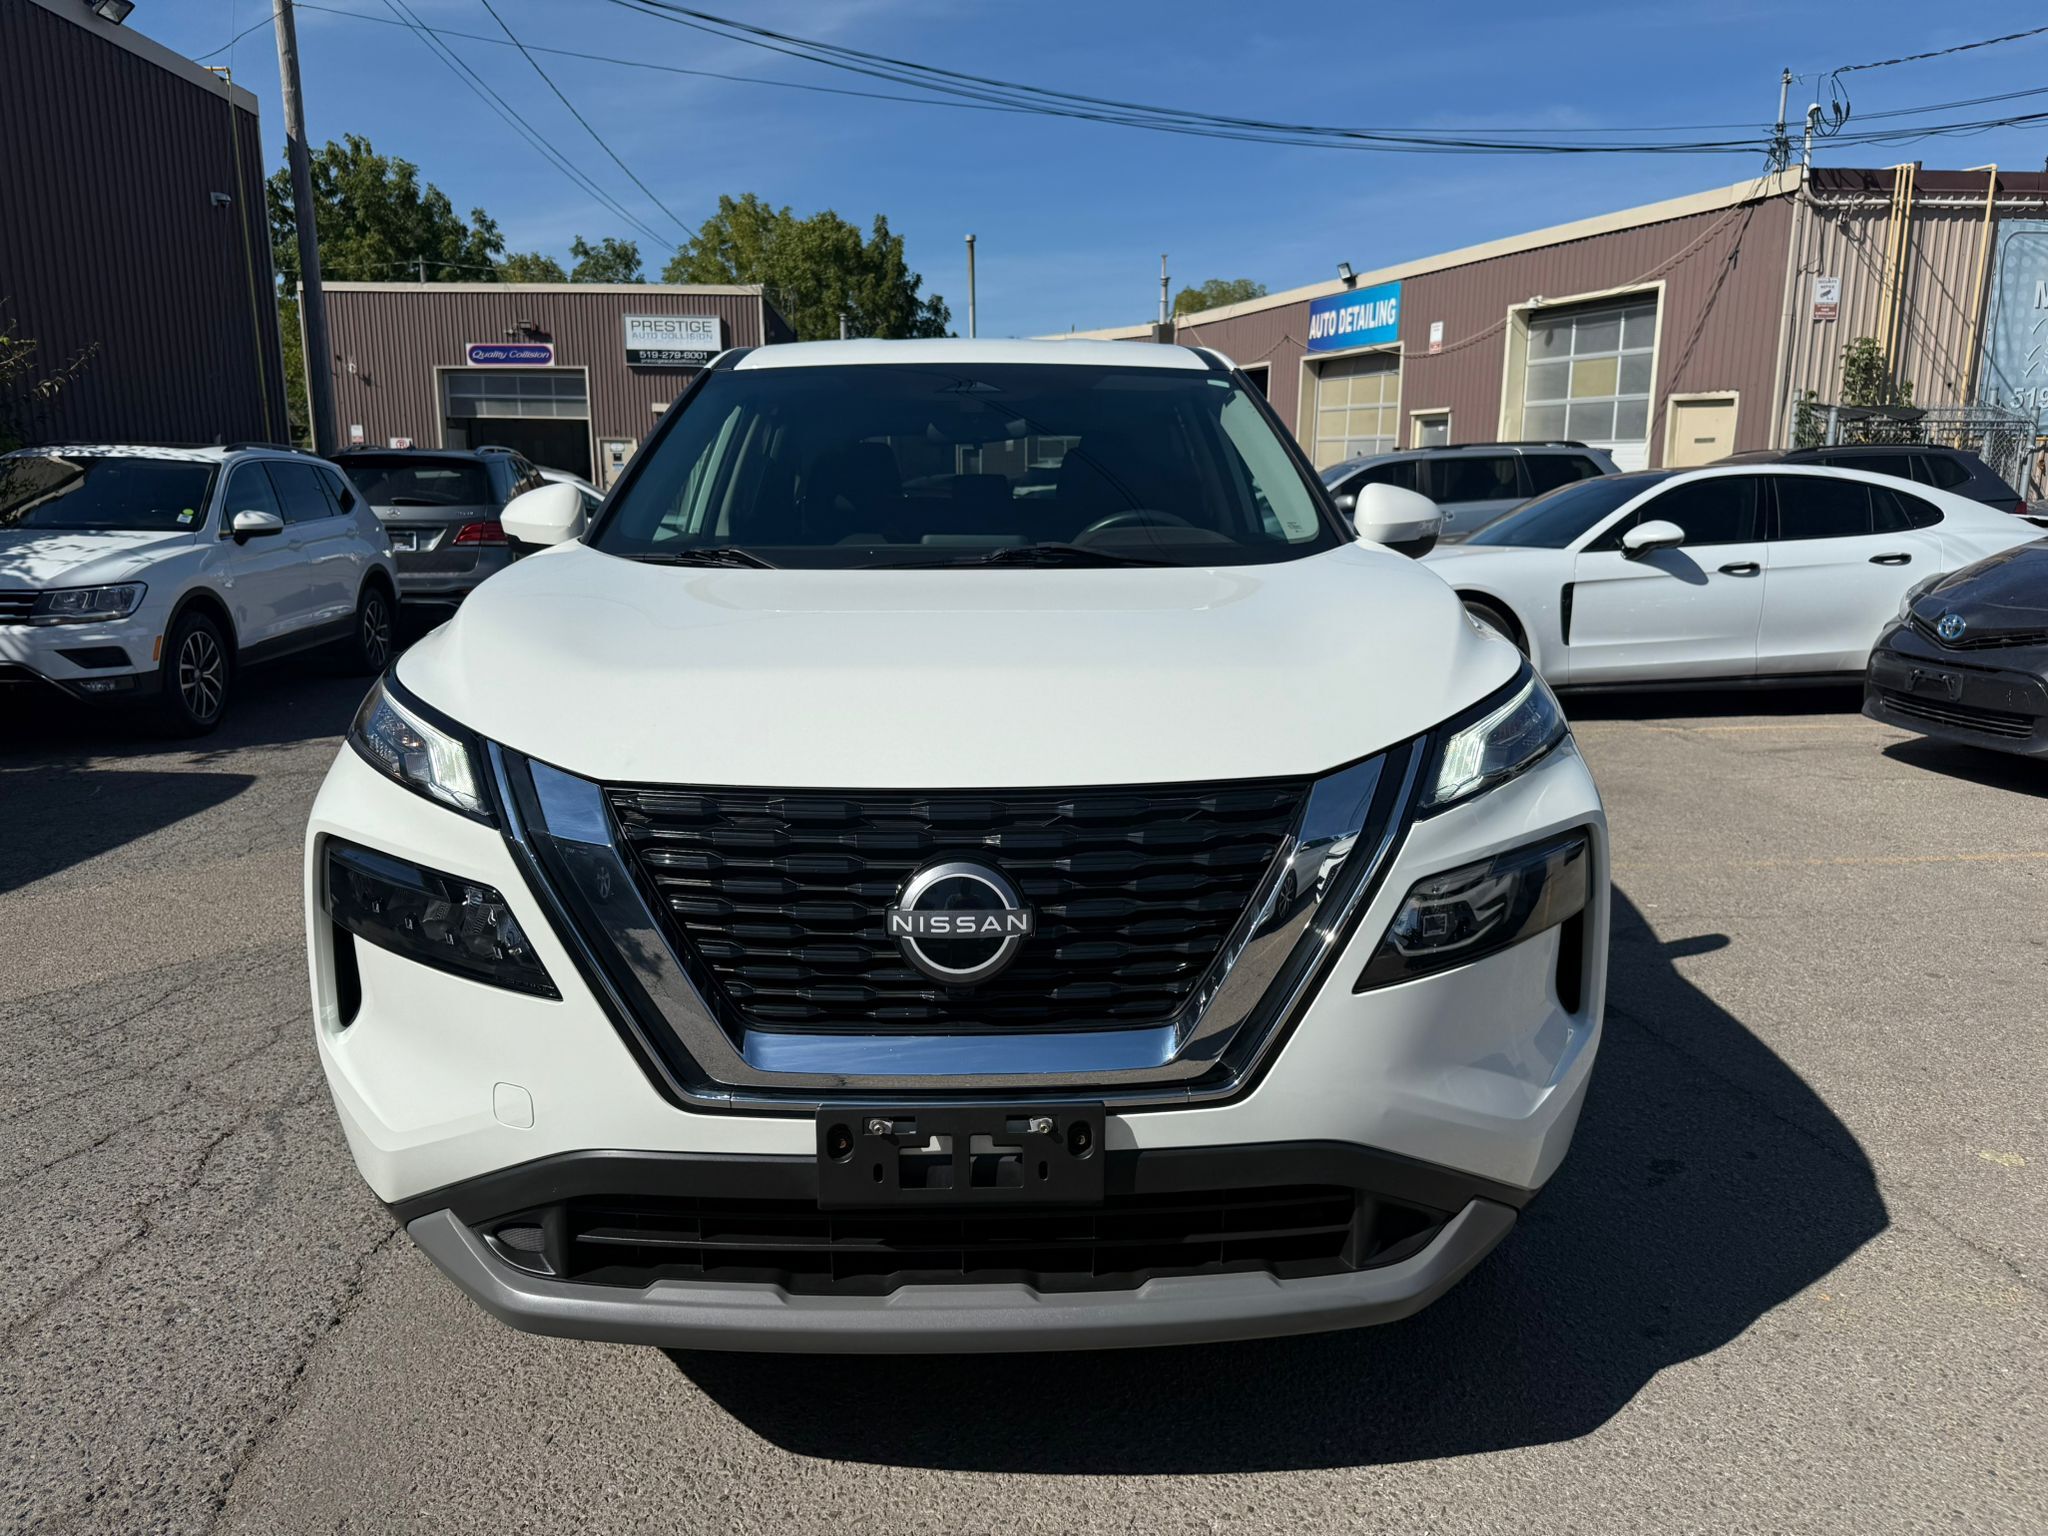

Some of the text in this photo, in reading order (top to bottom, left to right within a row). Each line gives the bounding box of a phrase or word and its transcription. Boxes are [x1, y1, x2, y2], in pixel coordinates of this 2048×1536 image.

[1309, 298, 1396, 340] AUTO DETAILING
[631, 320, 712, 333] PRESTIGE
[632, 332, 713, 341] AUTO COLLISION
[472, 350, 549, 359] Quality Collision
[639, 351, 708, 359] 519-279-6001
[892, 914, 1027, 933] NISSAN
